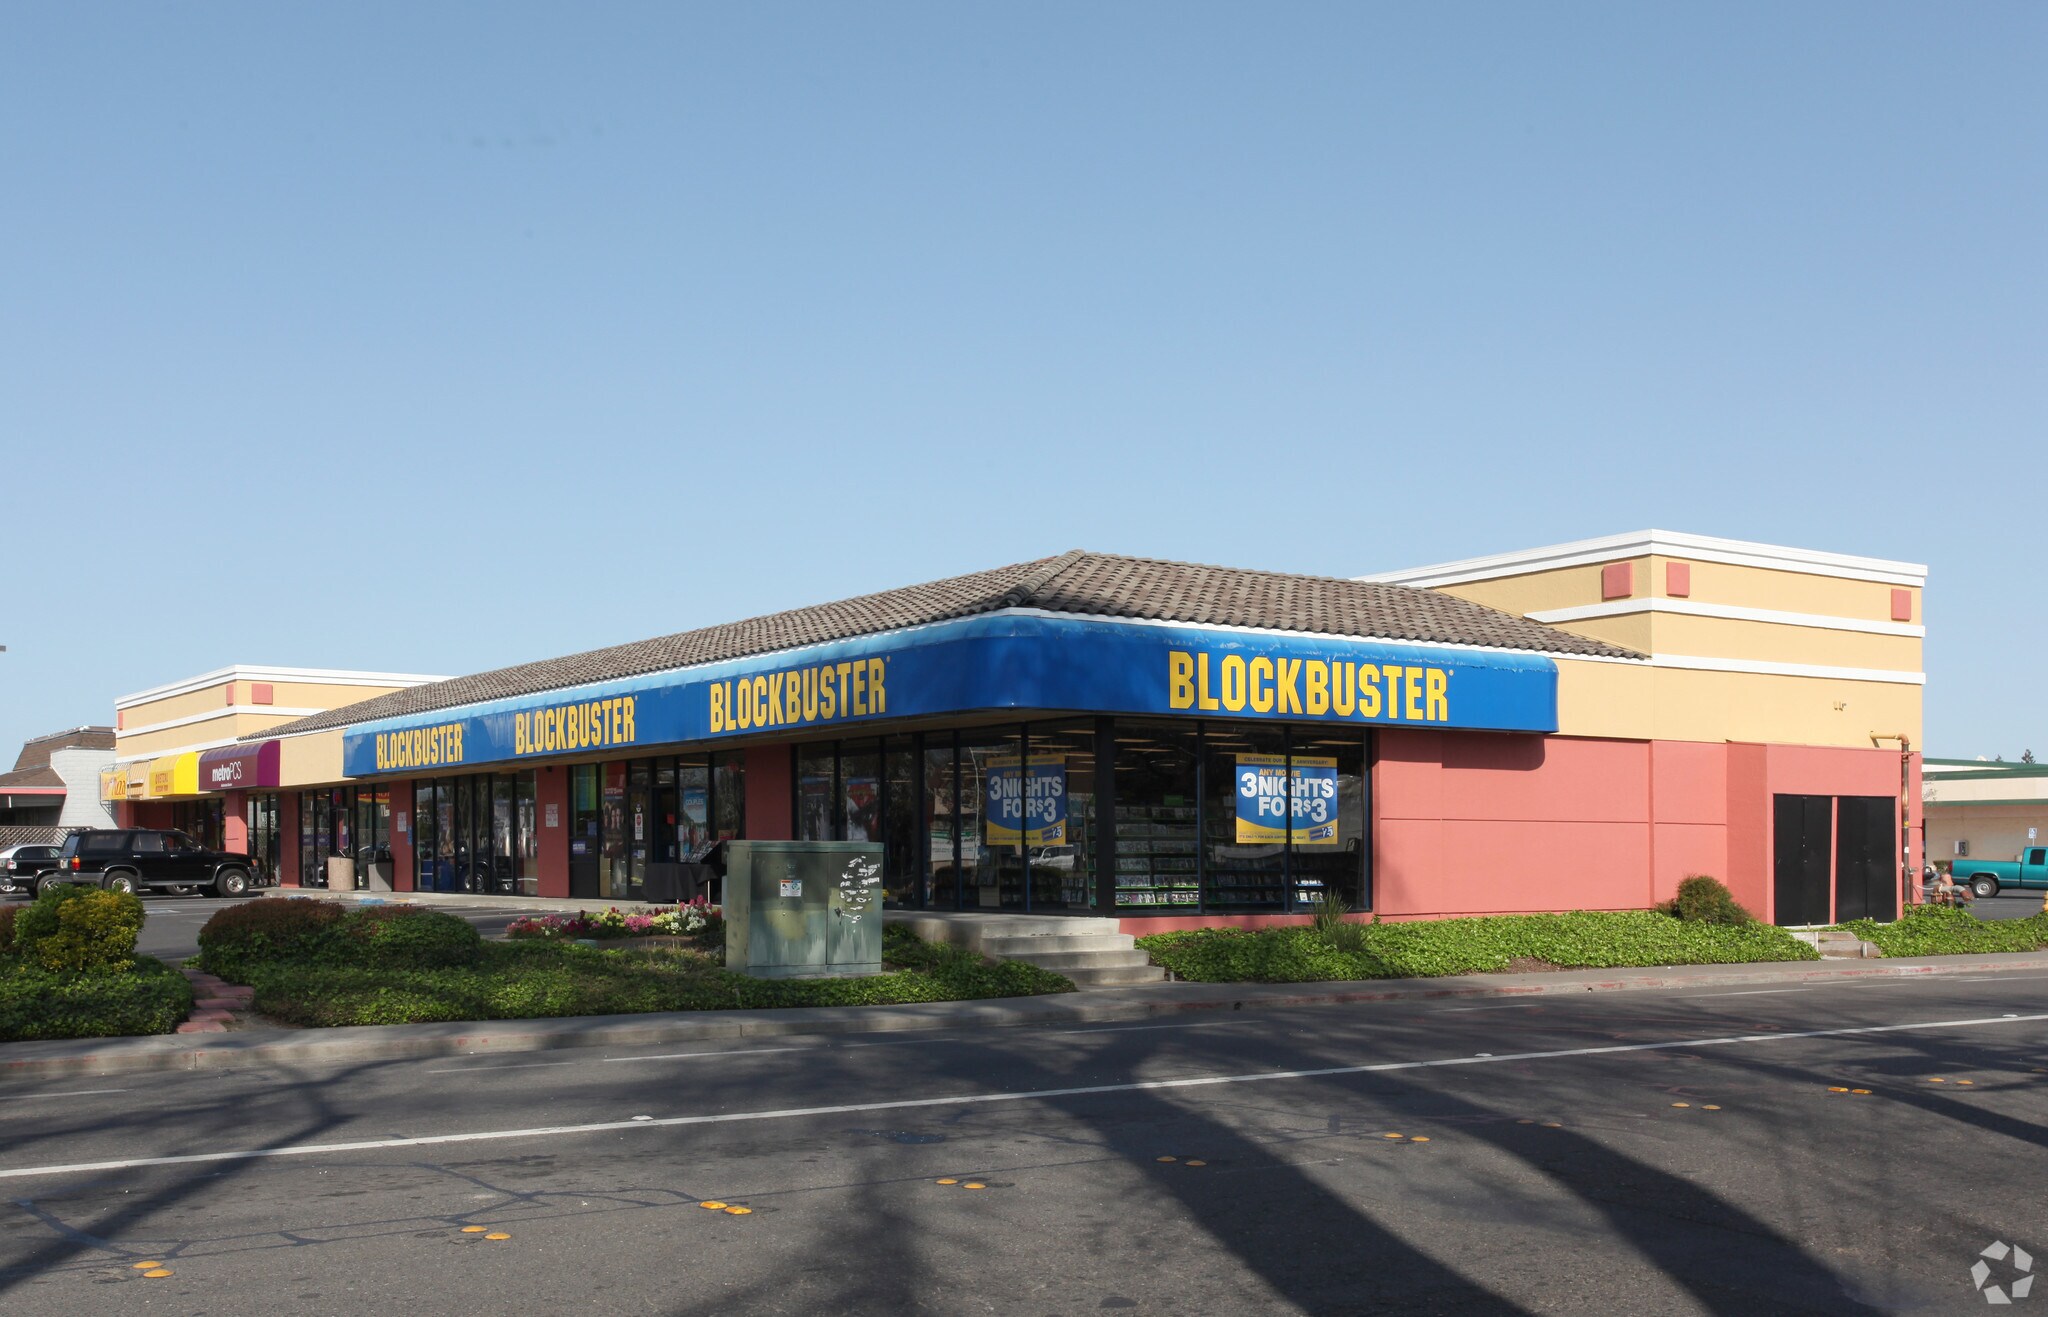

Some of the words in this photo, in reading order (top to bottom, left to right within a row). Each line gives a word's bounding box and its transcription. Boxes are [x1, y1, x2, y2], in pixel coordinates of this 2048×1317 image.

[710, 657, 886, 734] BLOCKBUSTER
[1169, 650, 1448, 722] BLOCKBUSTER
[376, 723, 463, 770] BLOCKBUSTER
[515, 696, 635, 755] BLOCKBUSTER
[212, 761, 242, 782] metroPCS
[1002, 798, 1037, 818] FOR
[1258, 796, 1303, 817] FOR
